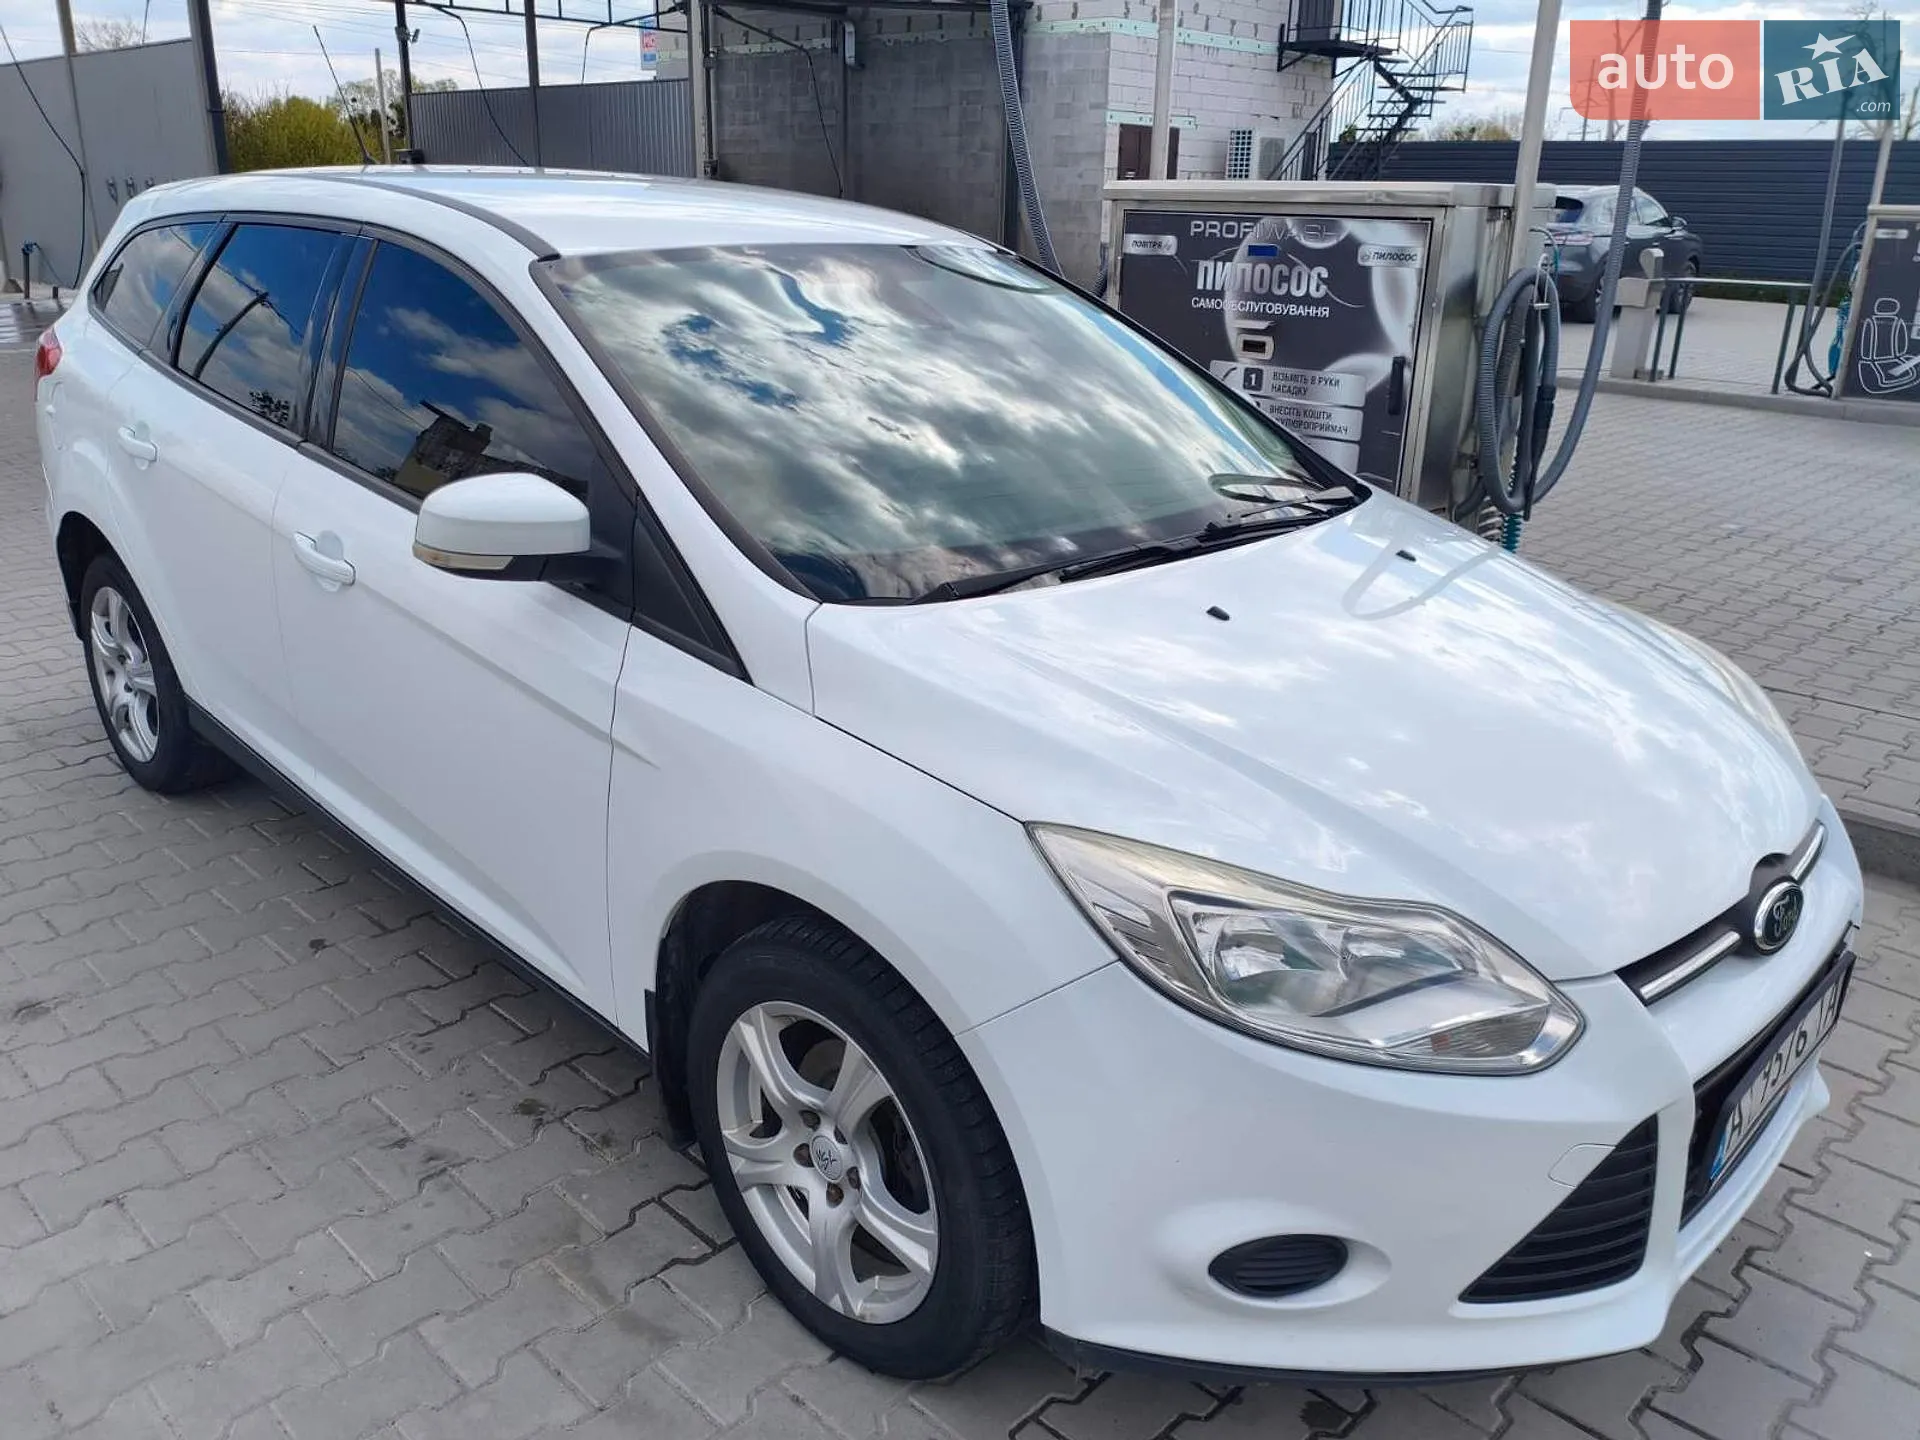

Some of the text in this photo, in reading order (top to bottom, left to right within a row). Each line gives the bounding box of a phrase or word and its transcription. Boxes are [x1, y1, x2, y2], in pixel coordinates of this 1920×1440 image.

[1371, 251, 1418, 263] ПИЛОСОС
[1196, 259, 1329, 299] ПИЛОСОС
[1318, 376, 1340, 388] РУКИ
[1303, 408, 1332, 421] КОШТИ
